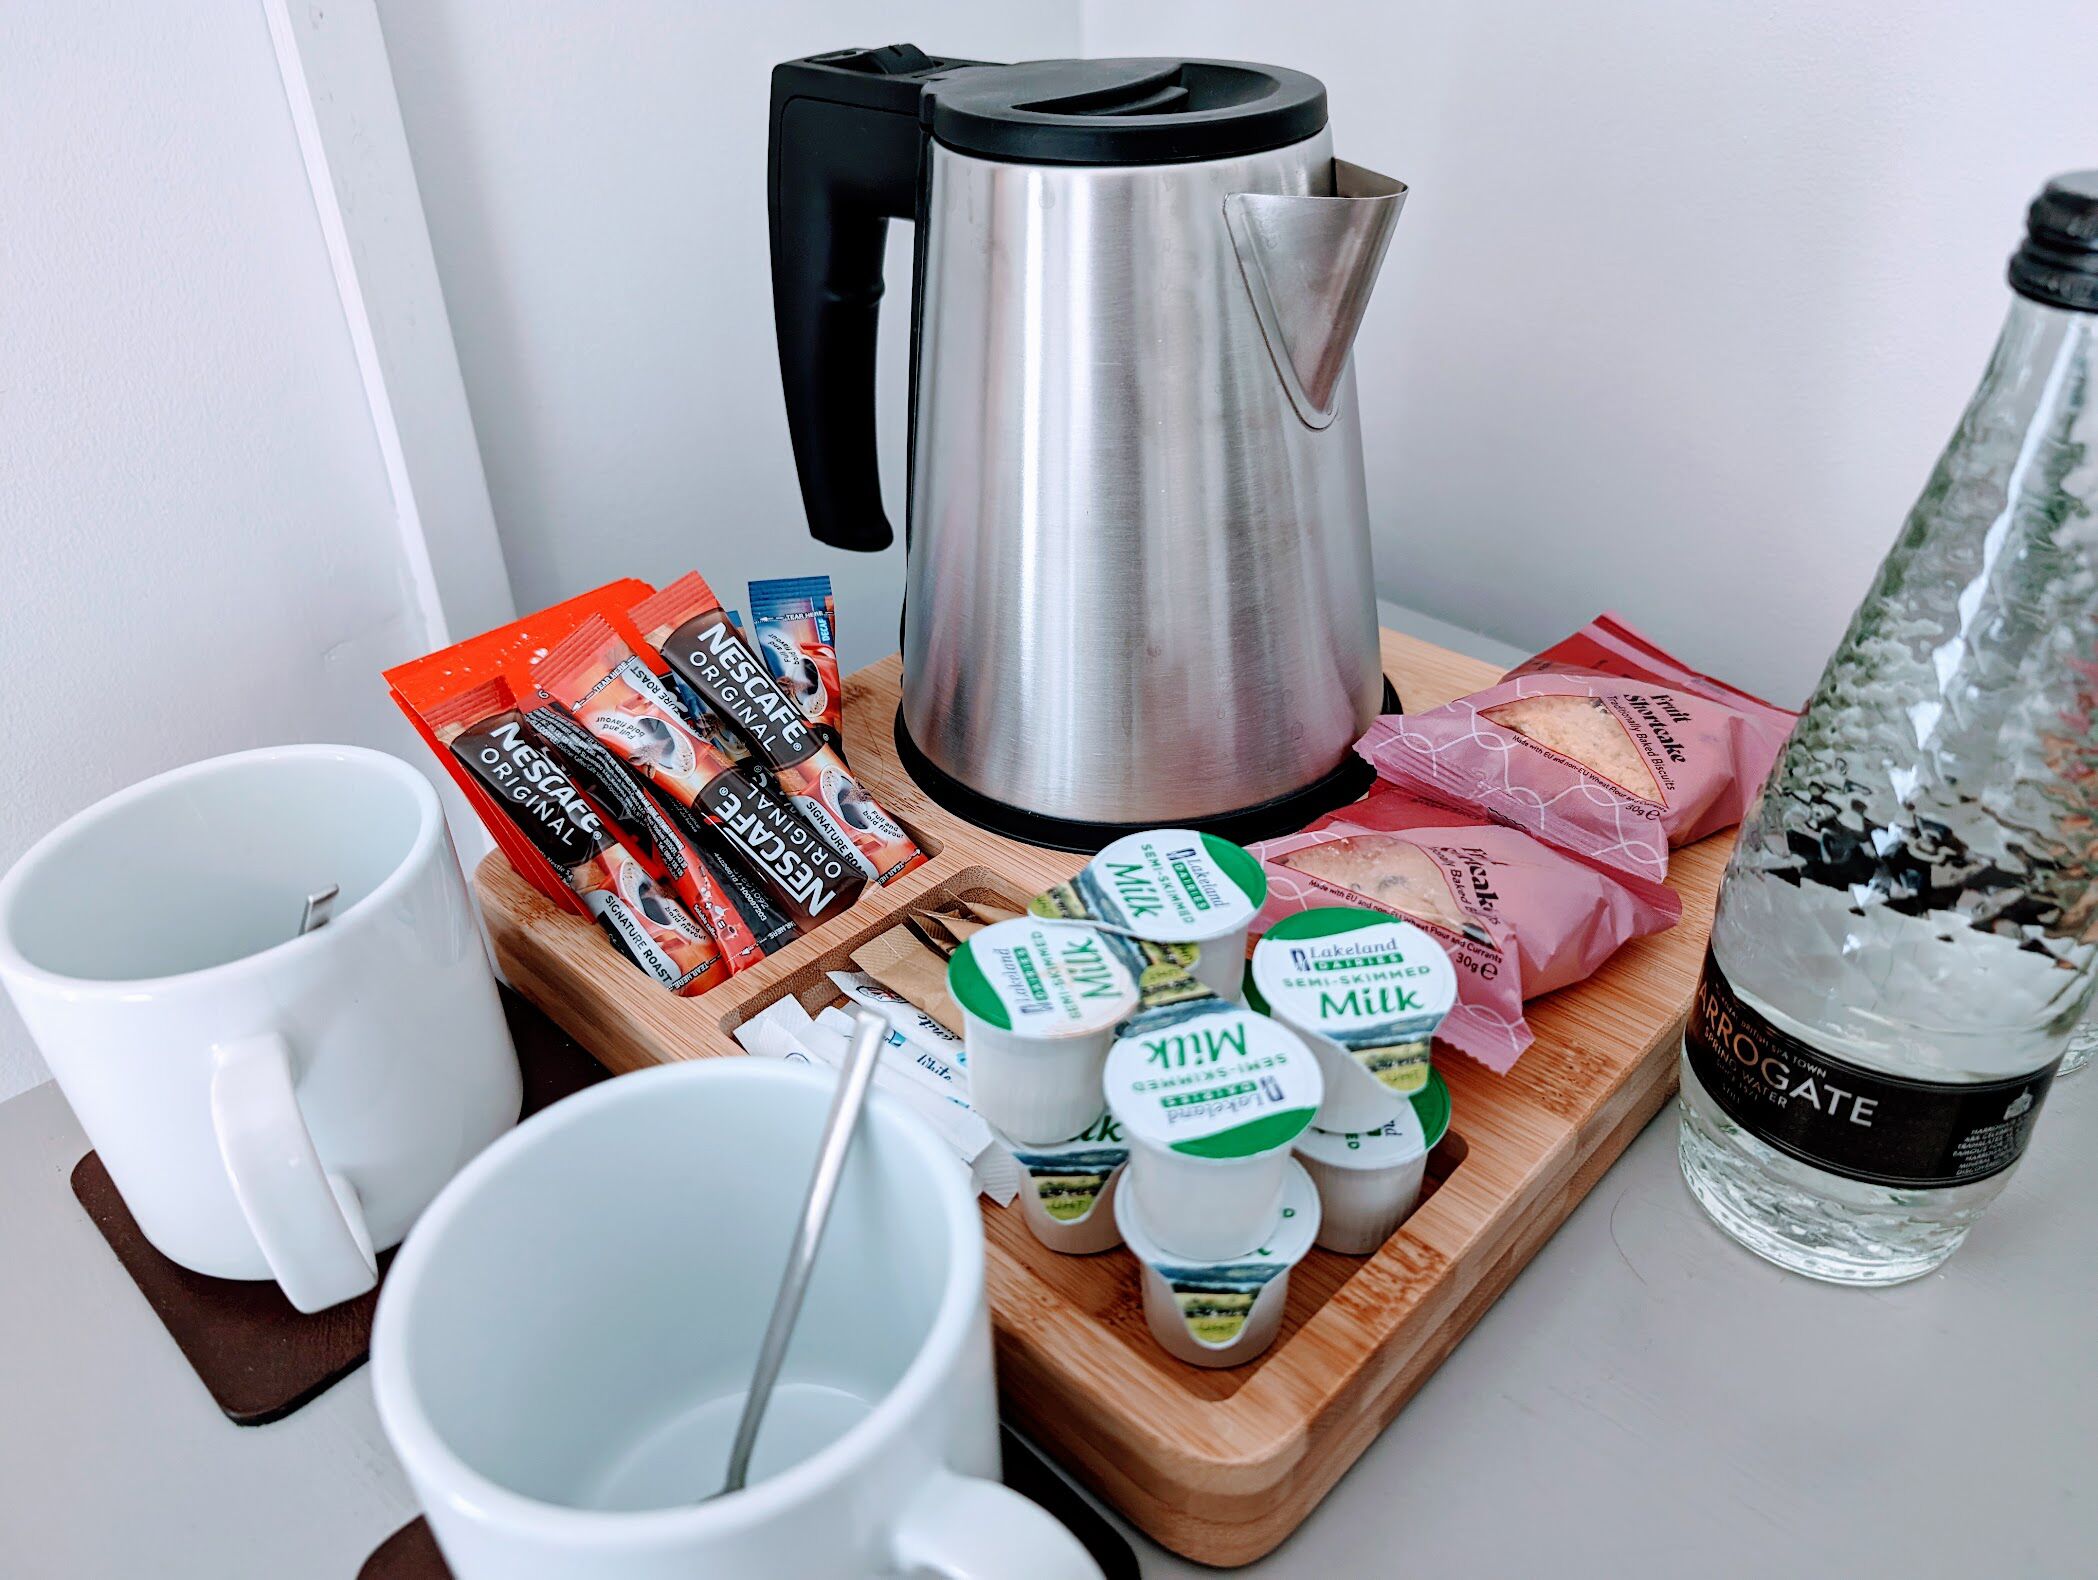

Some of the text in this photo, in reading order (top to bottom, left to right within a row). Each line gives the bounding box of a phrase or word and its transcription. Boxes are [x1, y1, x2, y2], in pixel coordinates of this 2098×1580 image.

[630, 665, 663, 695] ROAST
[689, 651, 777, 752] ORIGINAL
[1623, 694, 1686, 763] Shortcake
[1651, 694, 1692, 724] Fruit
[620, 727, 637, 741] Full
[1607, 695, 1676, 791] Traditionally Baked Biscuits
[1513, 734, 1529, 747] Made
[1530, 742, 1543, 755] with
[1543, 752, 1553, 761] EU
[1553, 756, 1566, 767] and
[1565, 760, 1589, 777] non-EU
[1589, 773, 1611, 790] Wheat
[1609, 785, 1627, 799] Flour
[480, 747, 575, 846] ORIGINAL
[862, 809, 879, 827] bold
[1625, 803, 1645, 817] 30g
[748, 782, 842, 879] ORIGINAL
[806, 801, 851, 855] SIGNATURE
[871, 809, 900, 832] Full and
[1105, 862, 1164, 918] Milk
[1141, 844, 1195, 923] SEMI-SKIMMED
[1173, 863, 1209, 909] DAIRIES
[1188, 859, 1230, 906] Lakeland
[664, 905, 681, 923] bold
[672, 907, 702, 934] Full and
[1309, 879, 1329, 891] Made
[1329, 887, 1345, 899] with
[1346, 893, 1358, 903] EU
[1357, 898, 1373, 909] and
[1430, 926, 1451, 941] Flour
[1451, 936, 1466, 948] and
[1467, 940, 1503, 964] Currants
[605, 894, 648, 951] SIGNATURE
[643, 948, 673, 983] ROAST
[1310, 938, 1398, 958] Lakeland
[1316, 953, 1401, 970] DAIRIES
[1062, 937, 1123, 998] Milk
[1283, 965, 1431, 988] SEMI-SKIMMED
[1456, 952, 1479, 972] 30g
[1320, 986, 1424, 1019] Milk
[1141, 1022, 1247, 1069] Milk
[1699, 979, 1879, 1127] ARROGATE
[1704, 1026, 1738, 1072] SPRING
[1742, 1070, 1788, 1110] WATER
[1771, 1045, 1790, 1062] SPA
[1792, 1057, 1827, 1078] TOWN
[1132, 1053, 1288, 1092] SEMI-SKIMMED
[1167, 1093, 1264, 1124] Lakeland
